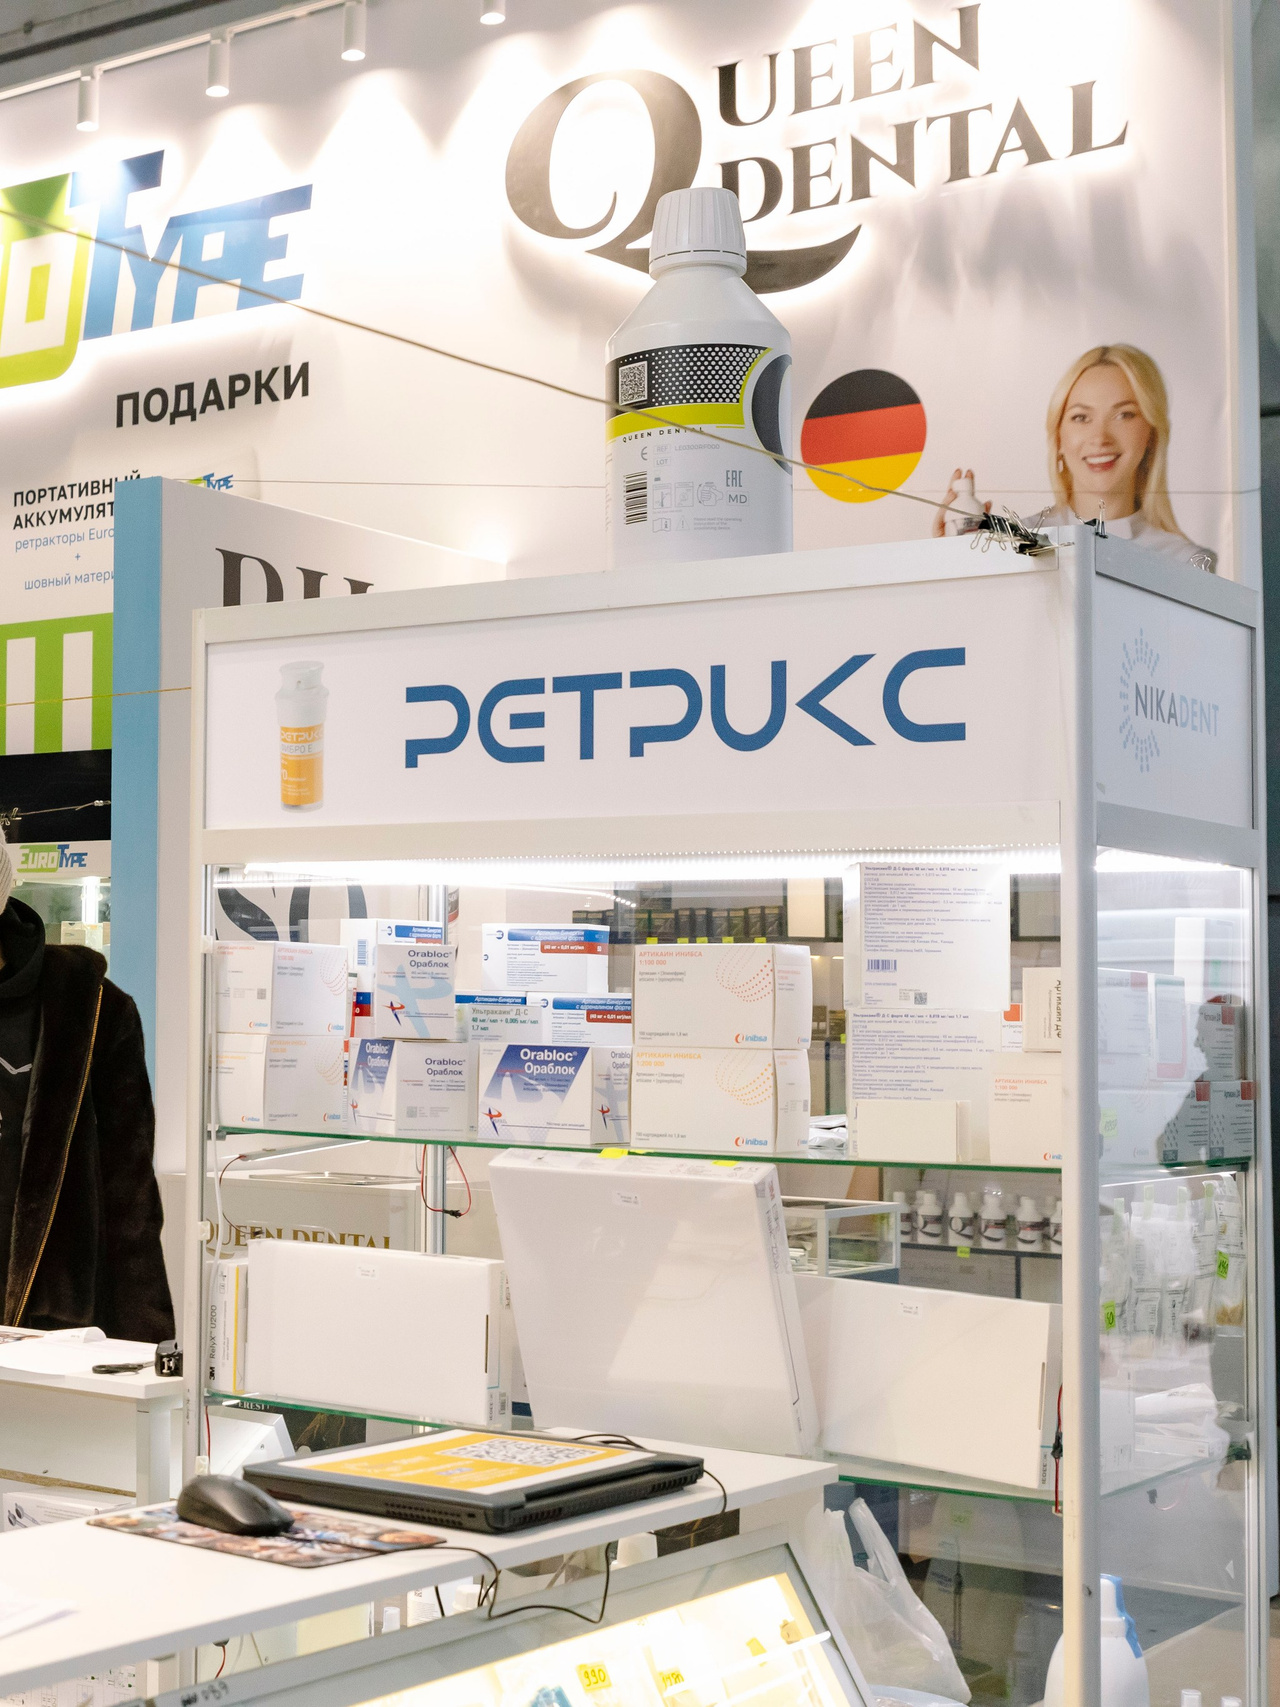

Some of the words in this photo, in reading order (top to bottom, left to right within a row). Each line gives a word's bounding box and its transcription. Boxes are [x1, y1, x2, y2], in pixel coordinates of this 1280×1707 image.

[505, 3, 981, 294] QUEEN
[719, 80, 1129, 223] DENTAL
[116, 362, 310, 428] ПОДАРКИ
[622, 432, 652, 443] QUEEN
[728, 494, 748, 504] MD
[15, 531, 85, 551] ретракторы
[24, 572, 70, 591] шовный
[1135, 682, 1219, 736] NIKADENT
[410, 960, 449, 969] Ораблок
[745, 1034, 768, 1042] inibsa
[426, 1067, 463, 1077] Ораблок
[525, 1062, 576, 1075] Ораблок
[745, 1138, 768, 1146] inibsa
[209, 1366, 215, 1380] 3M
[583, 1668, 607, 1688] 990
